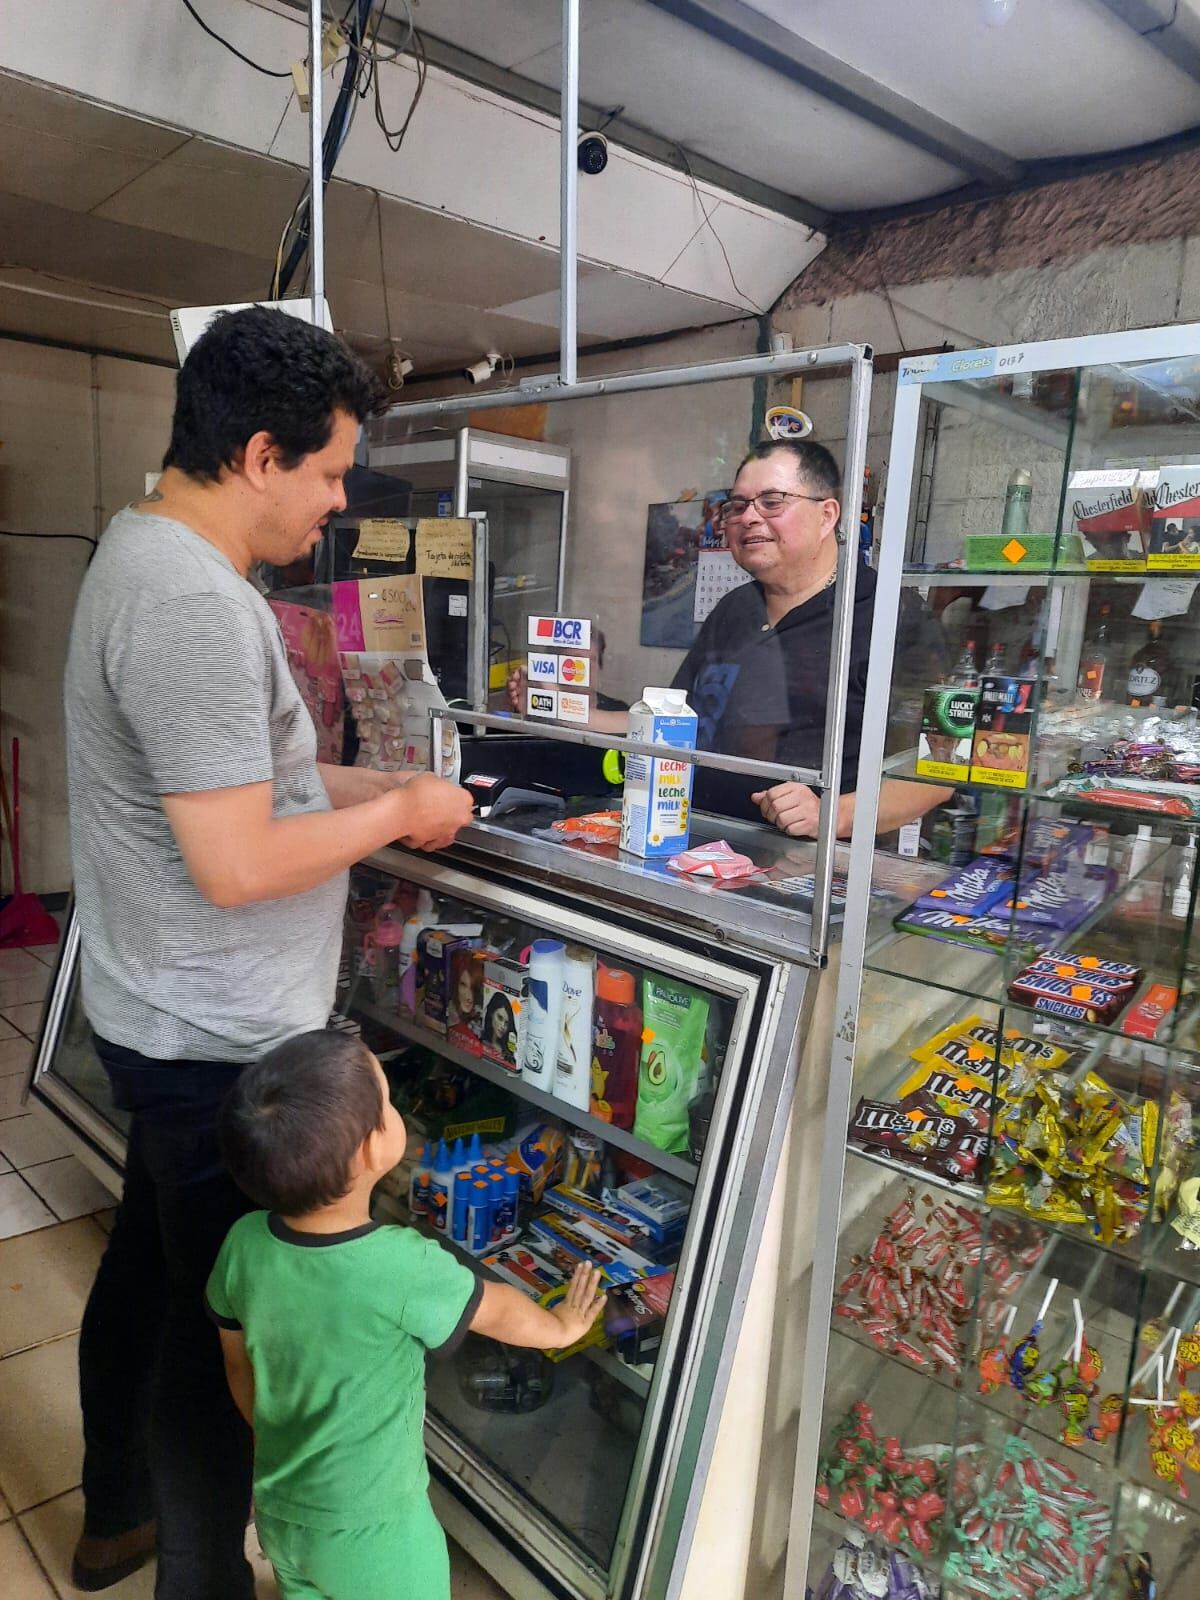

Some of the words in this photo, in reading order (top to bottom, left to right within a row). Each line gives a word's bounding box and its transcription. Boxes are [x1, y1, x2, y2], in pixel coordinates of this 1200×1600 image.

[952, 357, 992, 371] Clorets
[1072, 488, 1134, 519] Chesterfield
[554, 619, 582, 640] BCR
[531, 659, 555, 675] VISA
[948, 709, 974, 719] STRIKE
[950, 700, 975, 711] LUCKY
[947, 867, 991, 901] Milka
[1021, 871, 1070, 910] Milka
[919, 910, 1019, 932] Mlka
[562, 982, 582, 997] Dove
[1036, 998, 1084, 1019] SNICKERS
